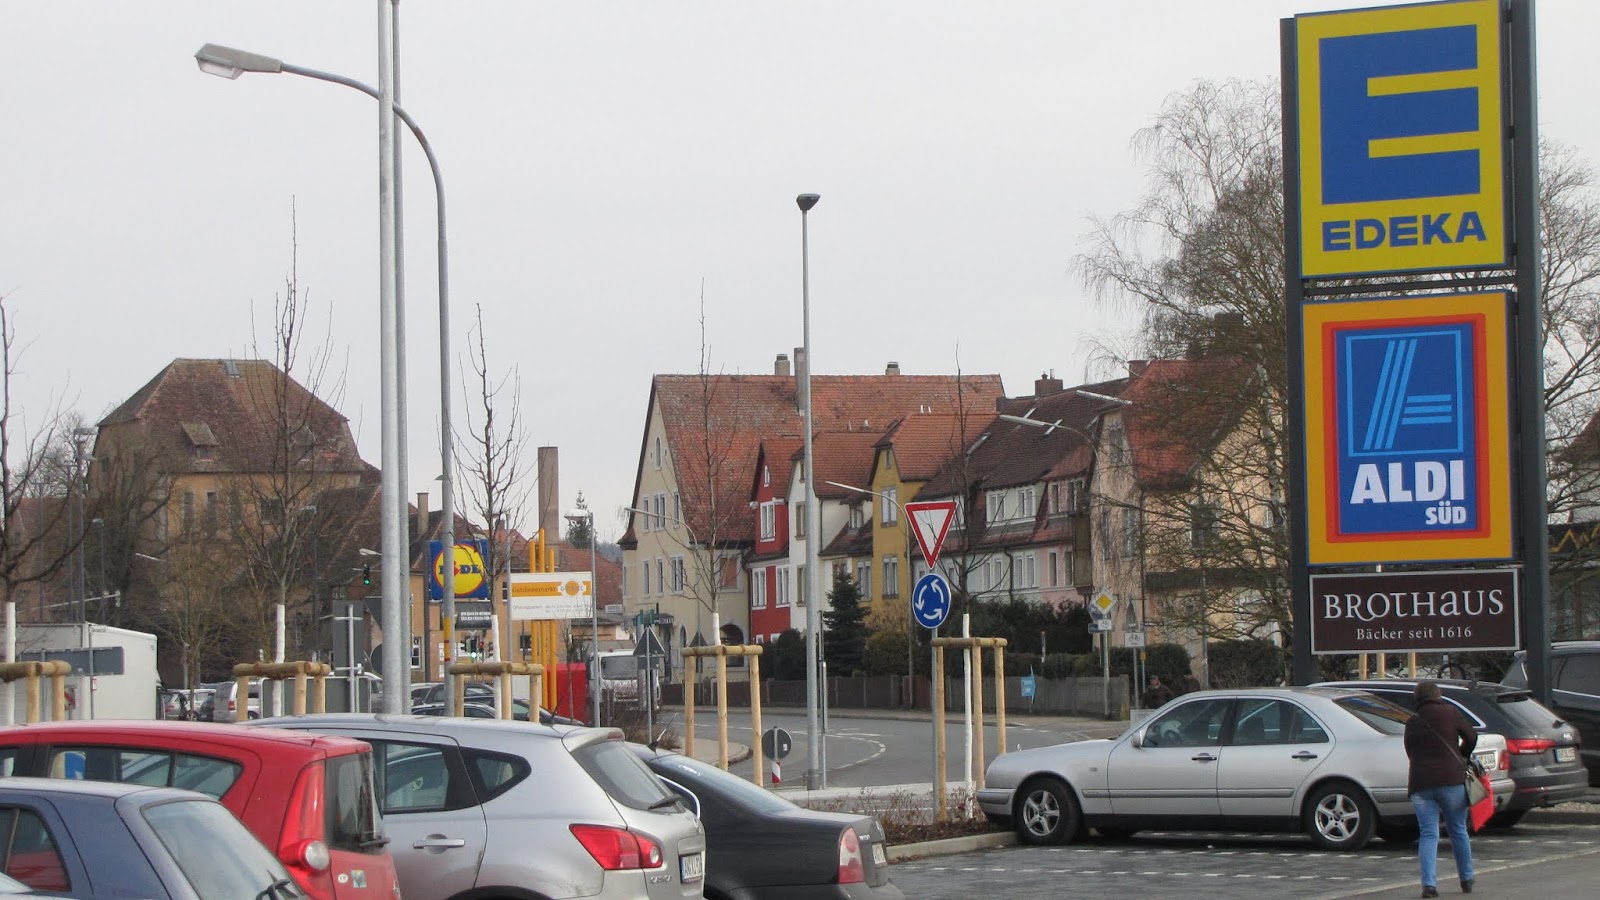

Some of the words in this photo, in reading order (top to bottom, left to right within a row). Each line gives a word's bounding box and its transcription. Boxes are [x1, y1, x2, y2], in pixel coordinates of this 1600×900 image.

[1319, 24, 1481, 205] E
[1322, 211, 1487, 252] EDEKA
[1350, 460, 1464, 504] ALDI
[1425, 500, 1466, 525] SÜD
[1356, 627, 1403, 640] Bäcker
[1408, 627, 1433, 639] seit
[1440, 626, 1472, 638] 1616
